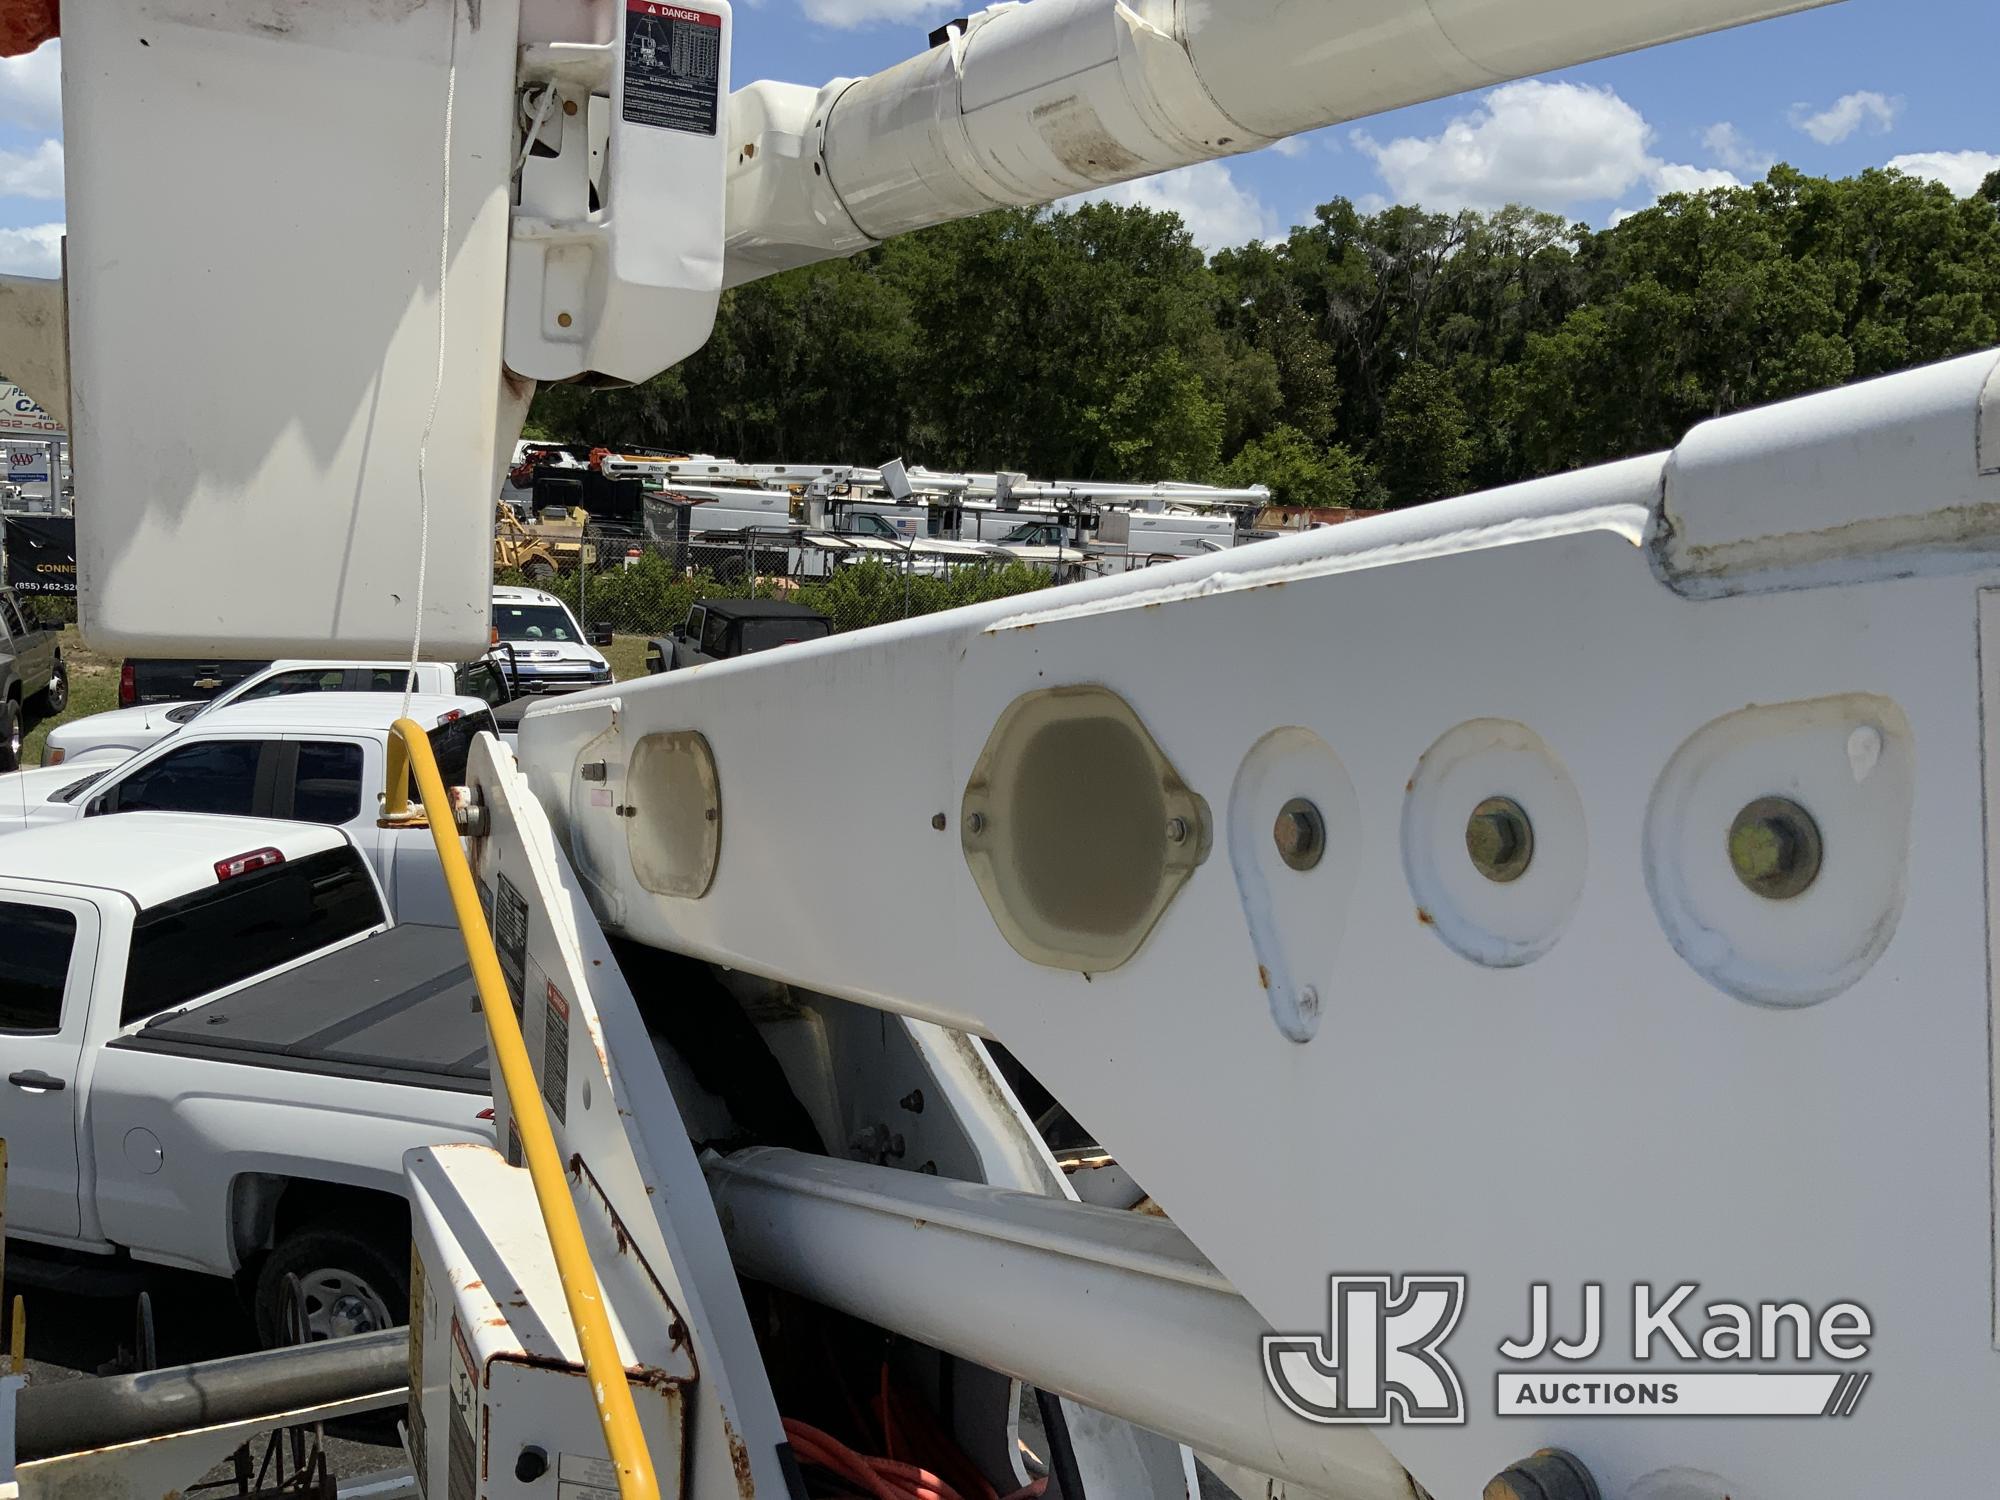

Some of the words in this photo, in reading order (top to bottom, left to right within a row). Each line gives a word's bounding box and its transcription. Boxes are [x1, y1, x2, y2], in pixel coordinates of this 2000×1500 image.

[661, 7, 700, 22] DANGER
[11, 453, 33, 465] AAA
[648, 464, 664, 472] Altec
[14, 582, 41, 591] (855)
